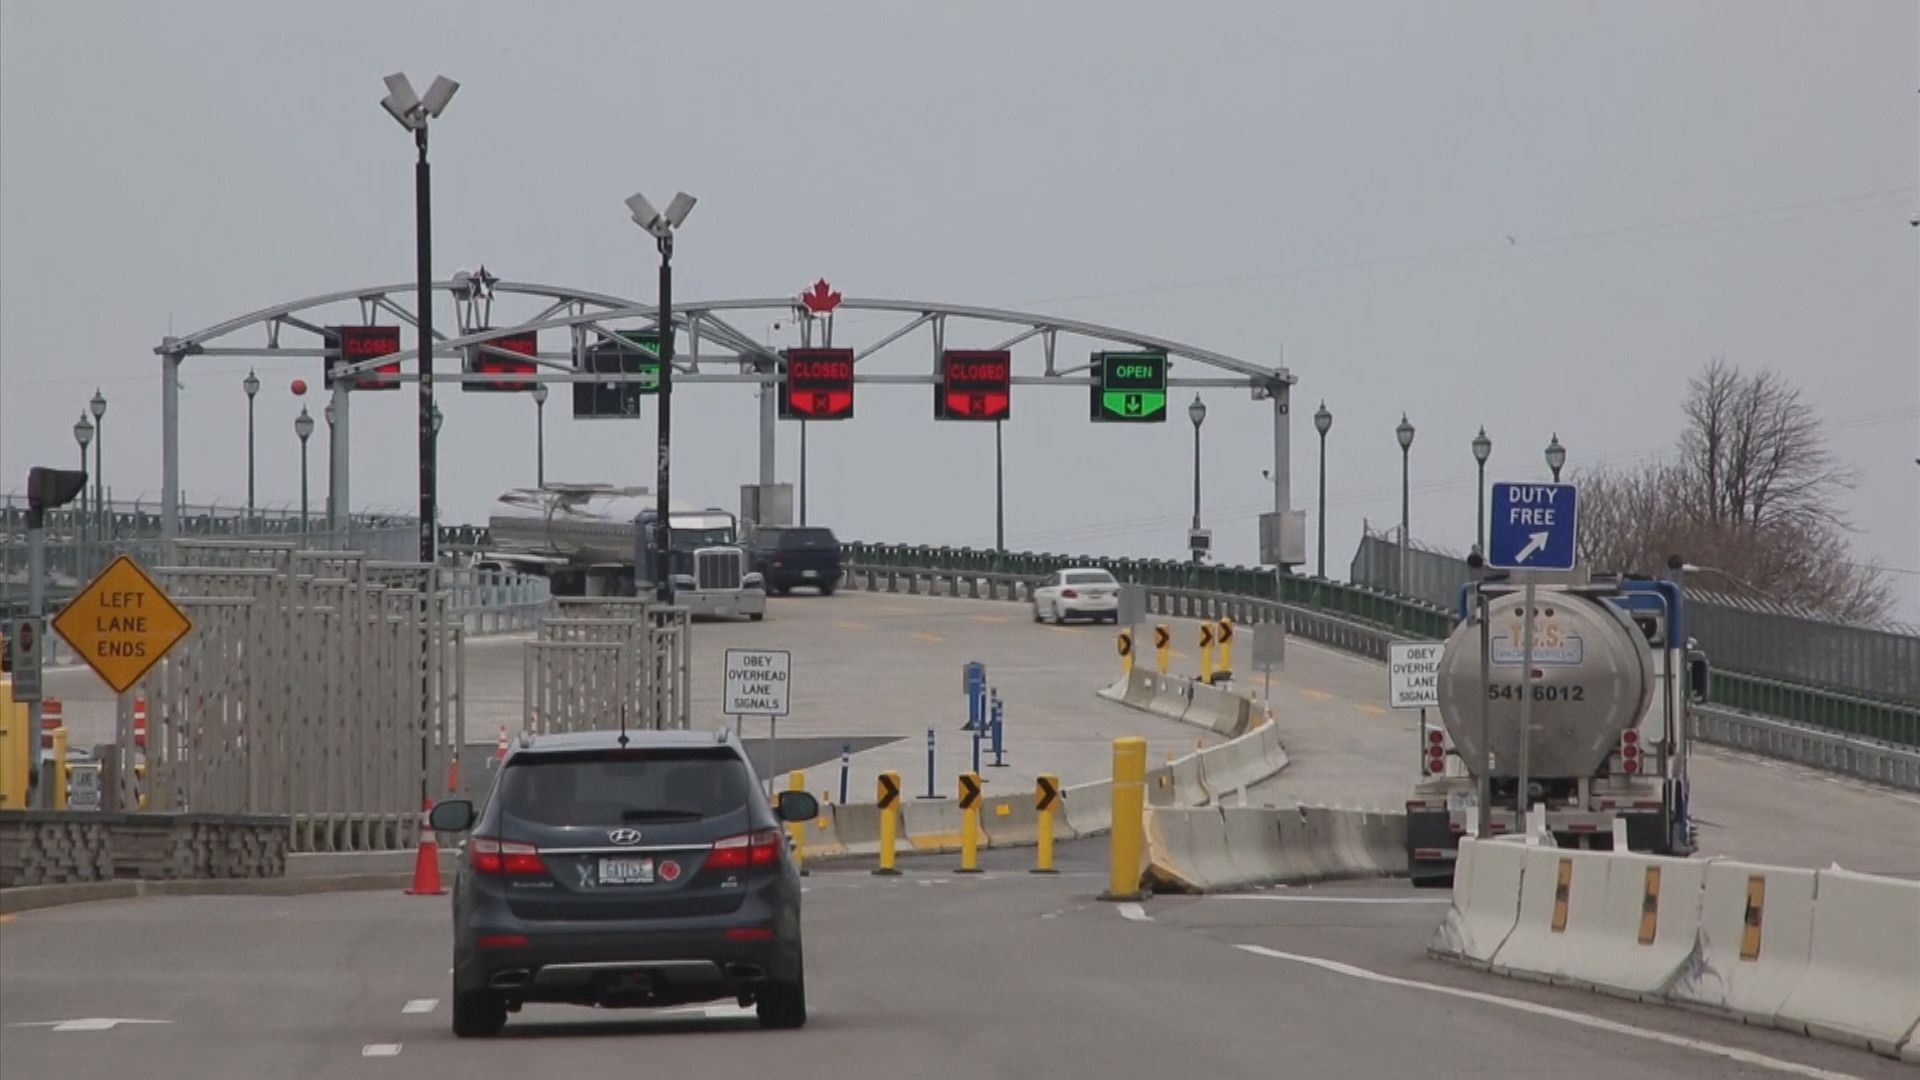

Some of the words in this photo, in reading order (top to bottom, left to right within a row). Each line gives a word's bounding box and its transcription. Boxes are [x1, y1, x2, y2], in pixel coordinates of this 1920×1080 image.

[793, 362, 849, 378] CLOSED
[950, 364, 1005, 379] CLOSED
[1116, 365, 1153, 379] OPEN
[1509, 486, 1558, 503] DUTY
[1510, 507, 1556, 525] FREE
[100, 592, 145, 608] LEFT
[96, 617, 147, 633] LANE
[97, 641, 146, 658] ENDS
[1407, 647, 1436, 659] OBEY
[743, 655, 772, 667] OBEY
[1393, 662, 1440, 673] OVERHEA
[728, 670, 786, 681] OVERHEAD
[1407, 677, 1436, 687] LANE
[742, 683, 771, 695] LANE
[1399, 691, 1437, 701] SIGNAL
[734, 698, 780, 709] SIGNALS
